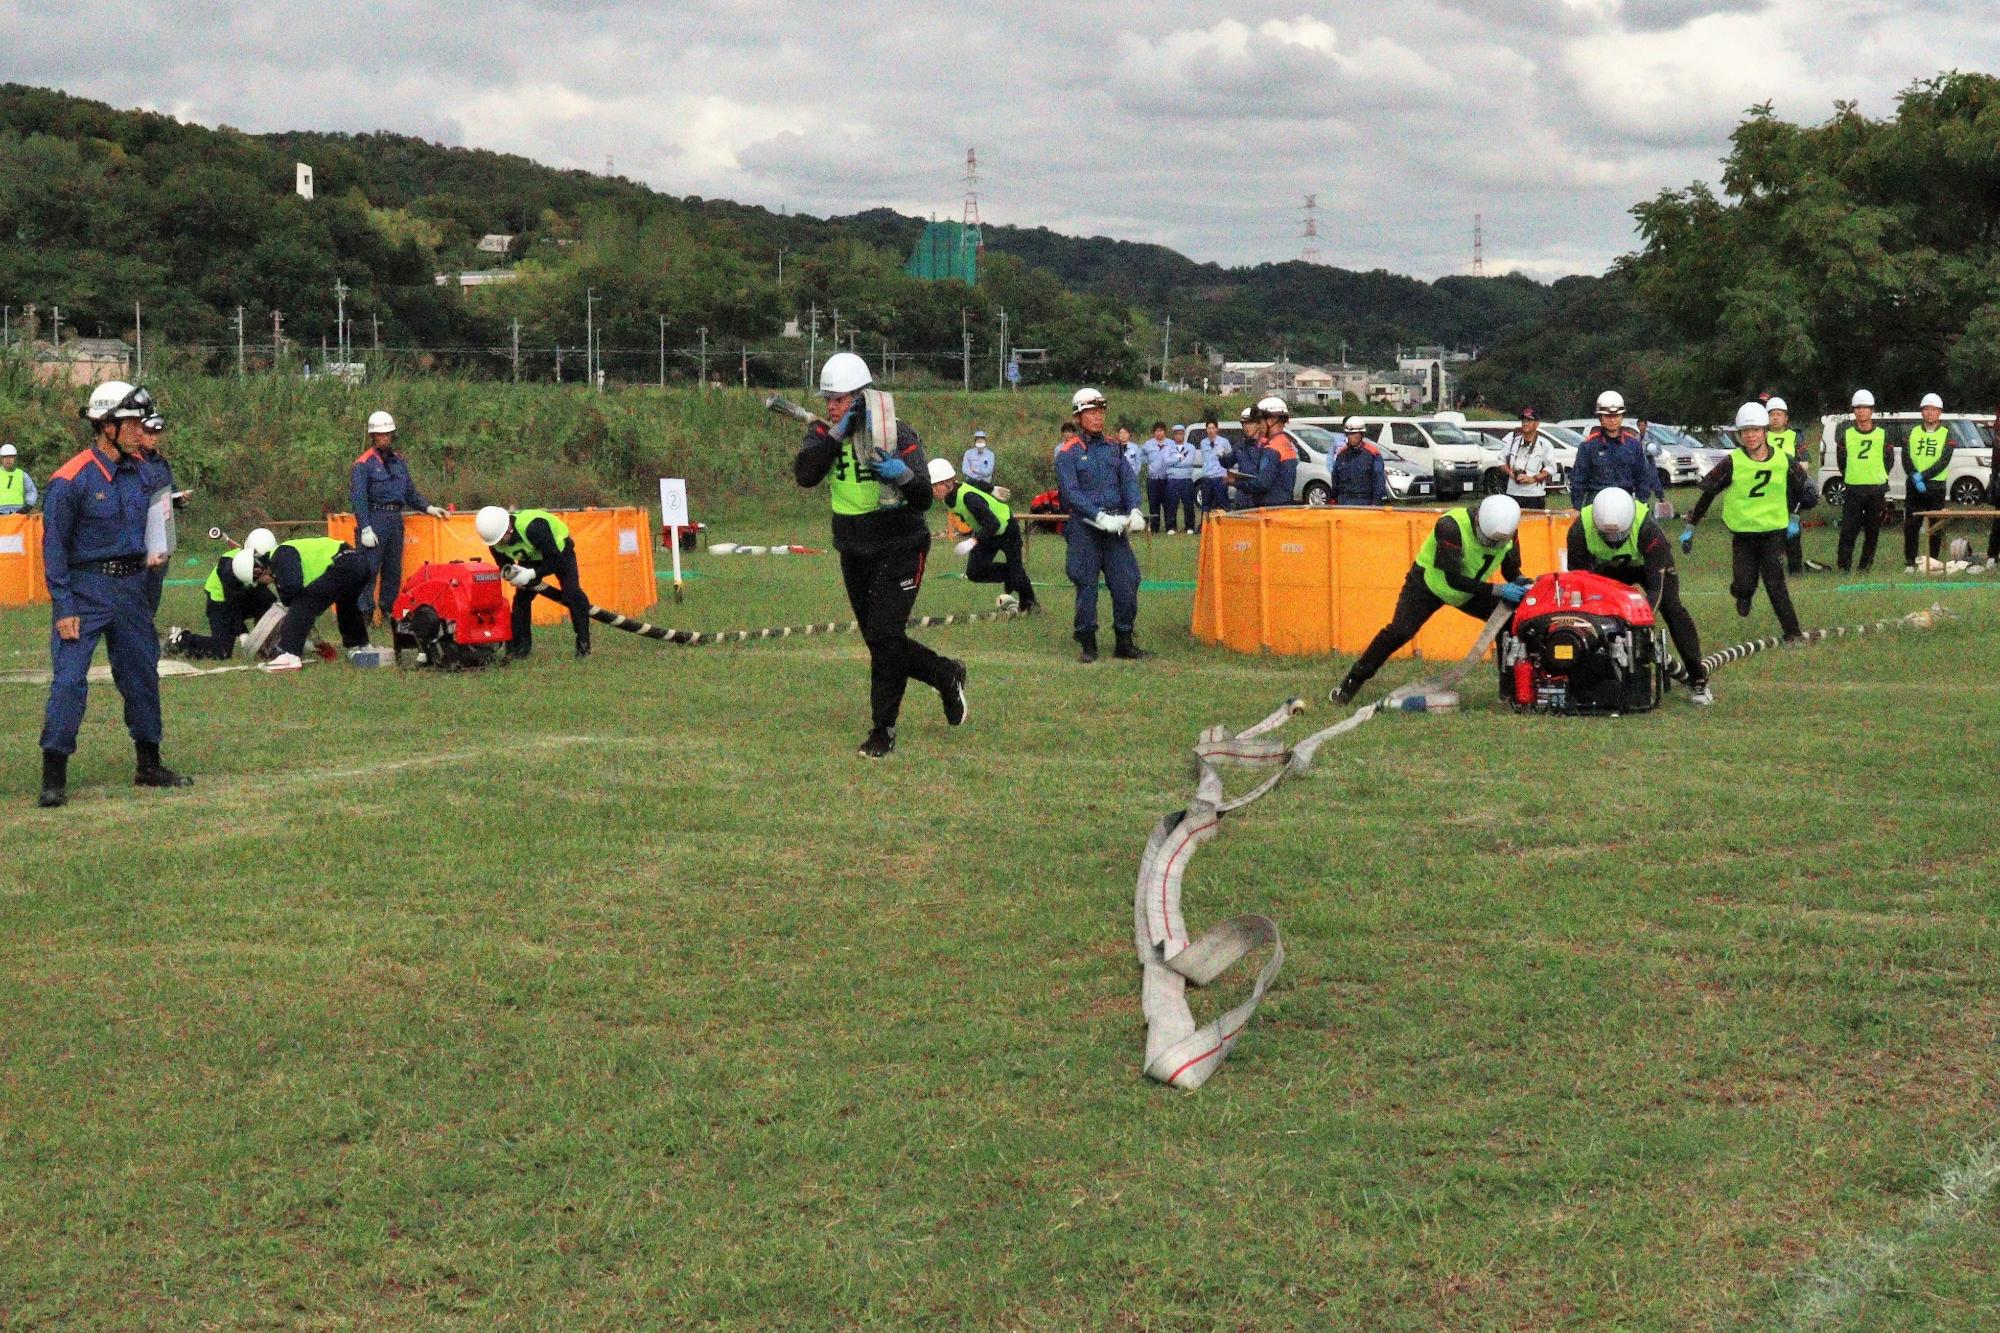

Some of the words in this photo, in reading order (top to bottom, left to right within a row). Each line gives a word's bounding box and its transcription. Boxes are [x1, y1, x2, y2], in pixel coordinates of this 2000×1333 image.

[1858, 439, 1873, 459] 2
[1916, 437, 1938, 457] 指
[1749, 469, 1772, 498] 2
